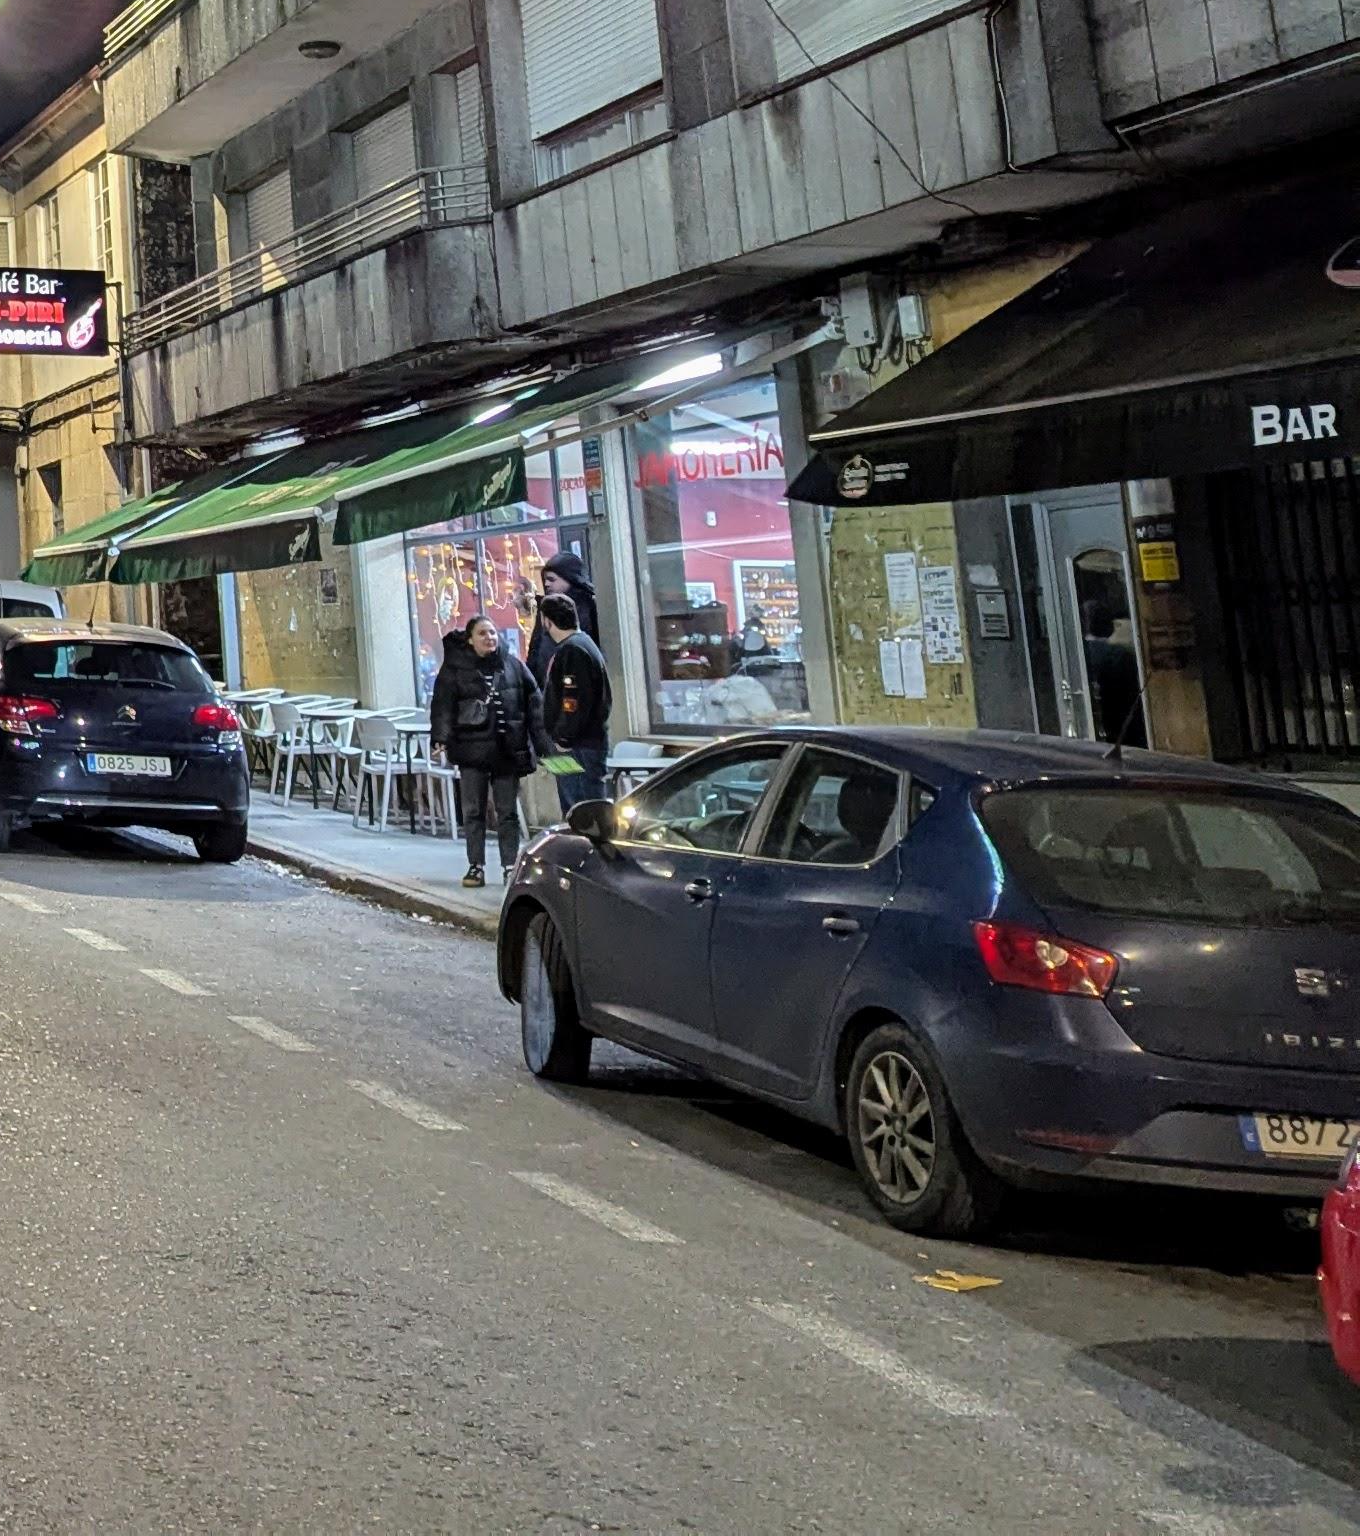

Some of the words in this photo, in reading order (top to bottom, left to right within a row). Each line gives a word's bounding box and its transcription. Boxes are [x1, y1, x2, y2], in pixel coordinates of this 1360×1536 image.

[26, 274, 58, 295] Bar
[1250, 404, 1339, 446] BAR
[97, 756, 135, 771] 0825
[140, 758, 167, 772] JSJ
[1267, 1116, 1351, 1148] 8872
